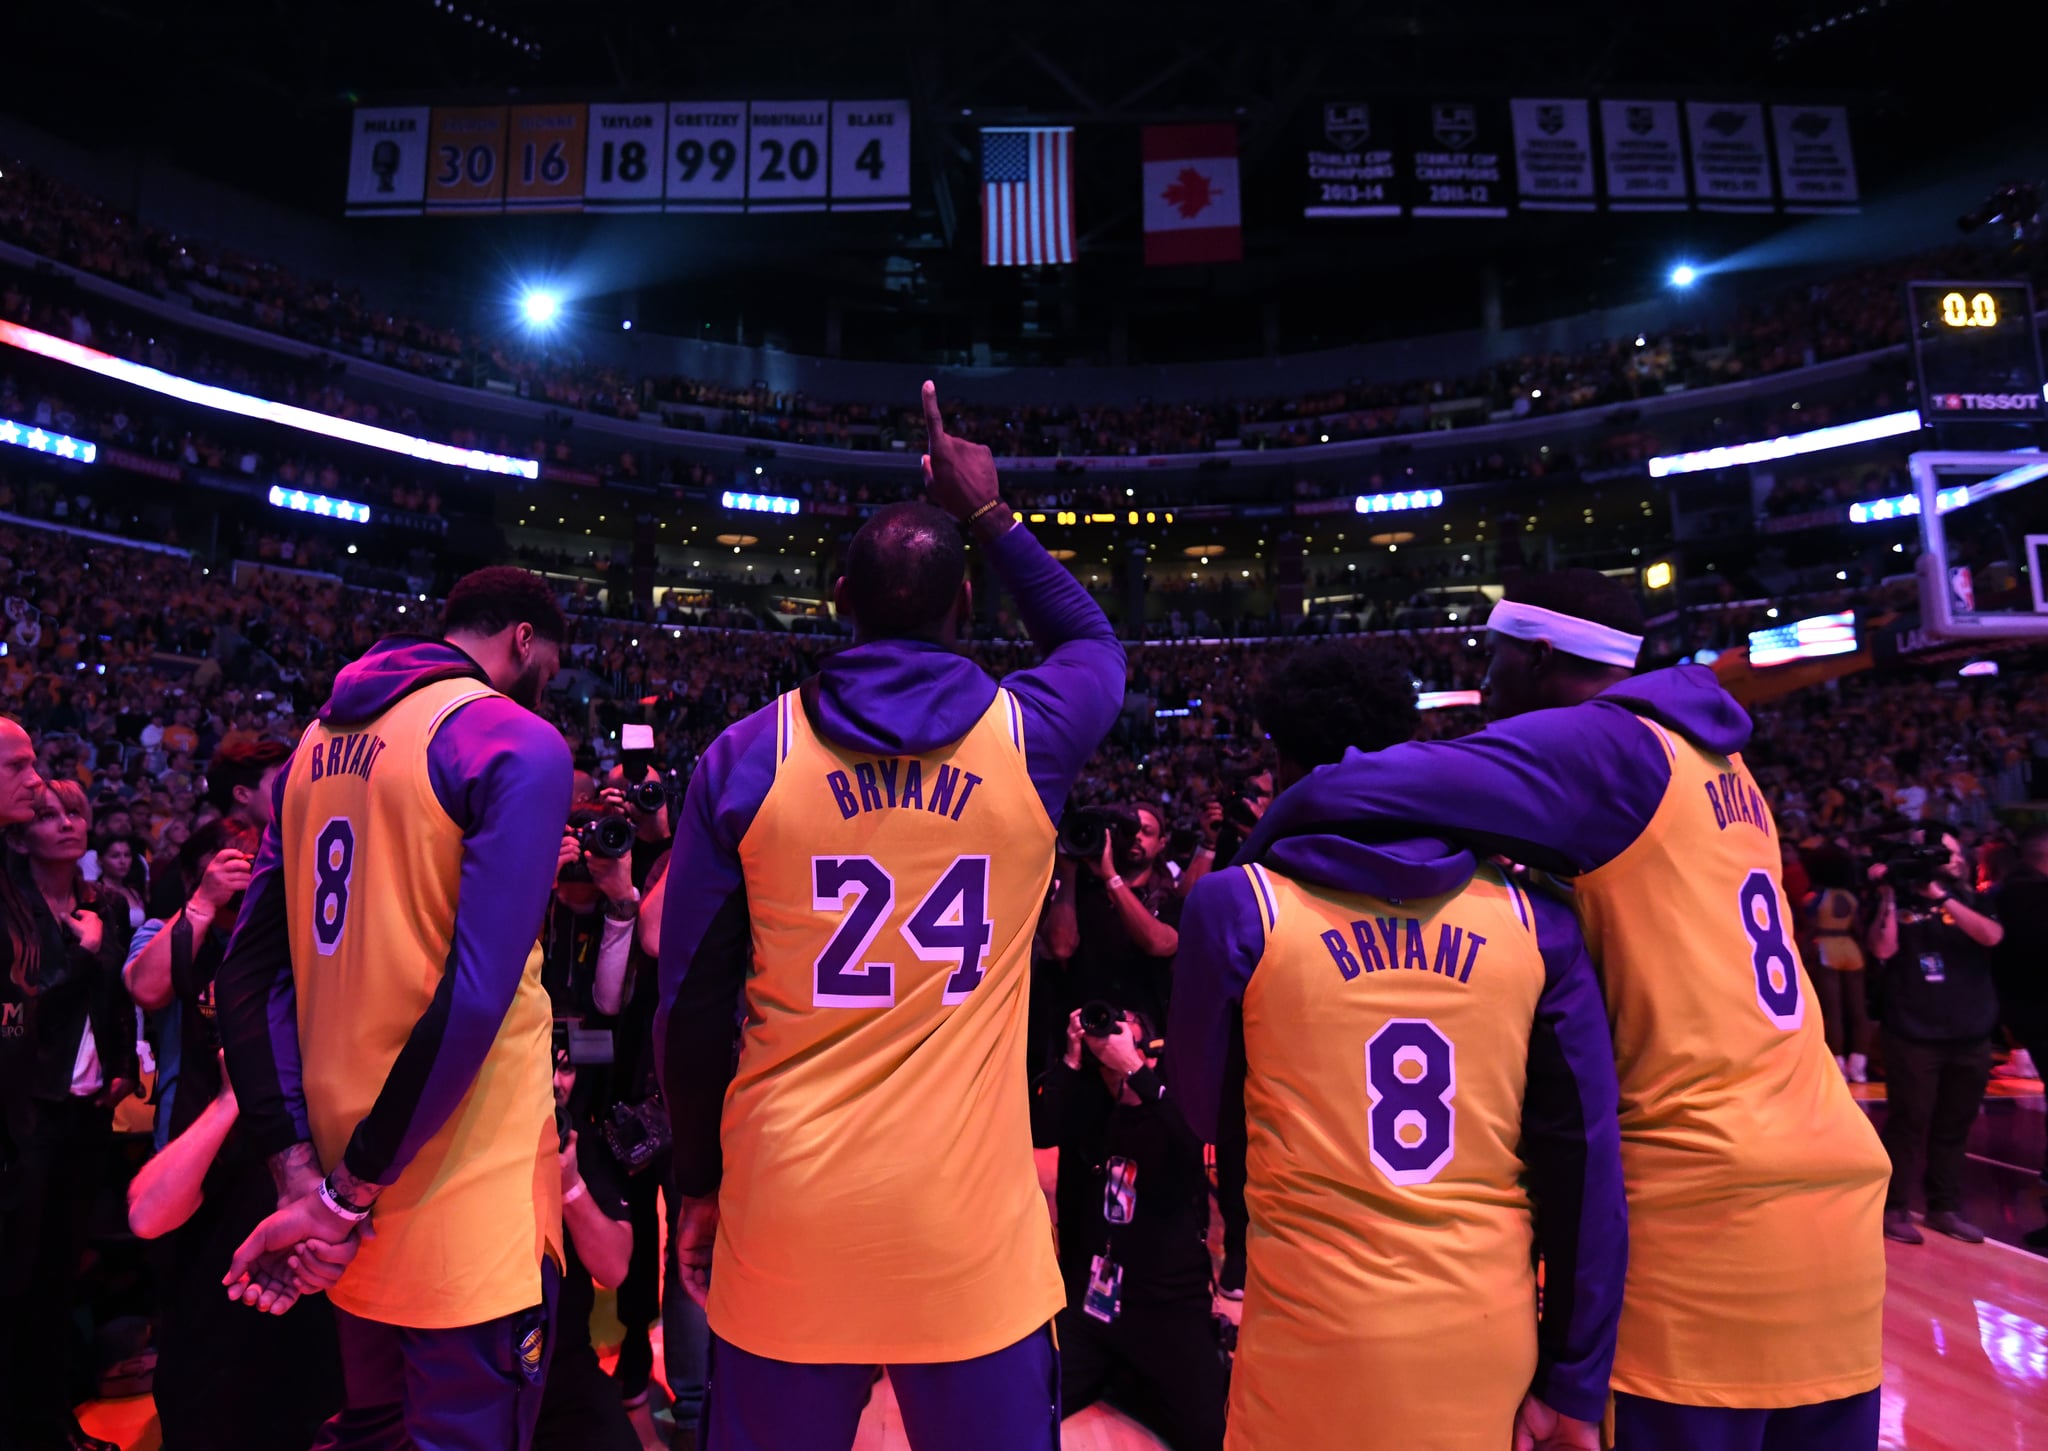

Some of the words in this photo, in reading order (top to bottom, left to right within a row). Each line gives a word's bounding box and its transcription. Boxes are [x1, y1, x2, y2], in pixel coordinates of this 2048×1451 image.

[364, 119, 417, 133] MILLER
[601, 115, 653, 128] TAYLOR
[675, 113, 740, 127] GRETZKY
[753, 113, 824, 127] ROBITAILLE
[848, 112, 894, 126] BLAKE
[436, 144, 496, 187] 30
[522, 141, 568, 186] 16
[602, 141, 647, 183] 18
[676, 139, 737, 182] 99
[758, 139, 819, 182] 20
[855, 139, 884, 180] 4
[1961, 393, 2040, 409] TISSOT
[312, 733, 386, 782] BRYANT
[826, 758, 983, 822] BRYANT
[1704, 771, 1770, 838] BRYANT
[313, 816, 356, 956] 8
[811, 854, 995, 1008] 24
[1320, 917, 1487, 984] BRYANT
[1738, 868, 1805, 1030] 8
[1365, 1018, 1456, 1186] 8
